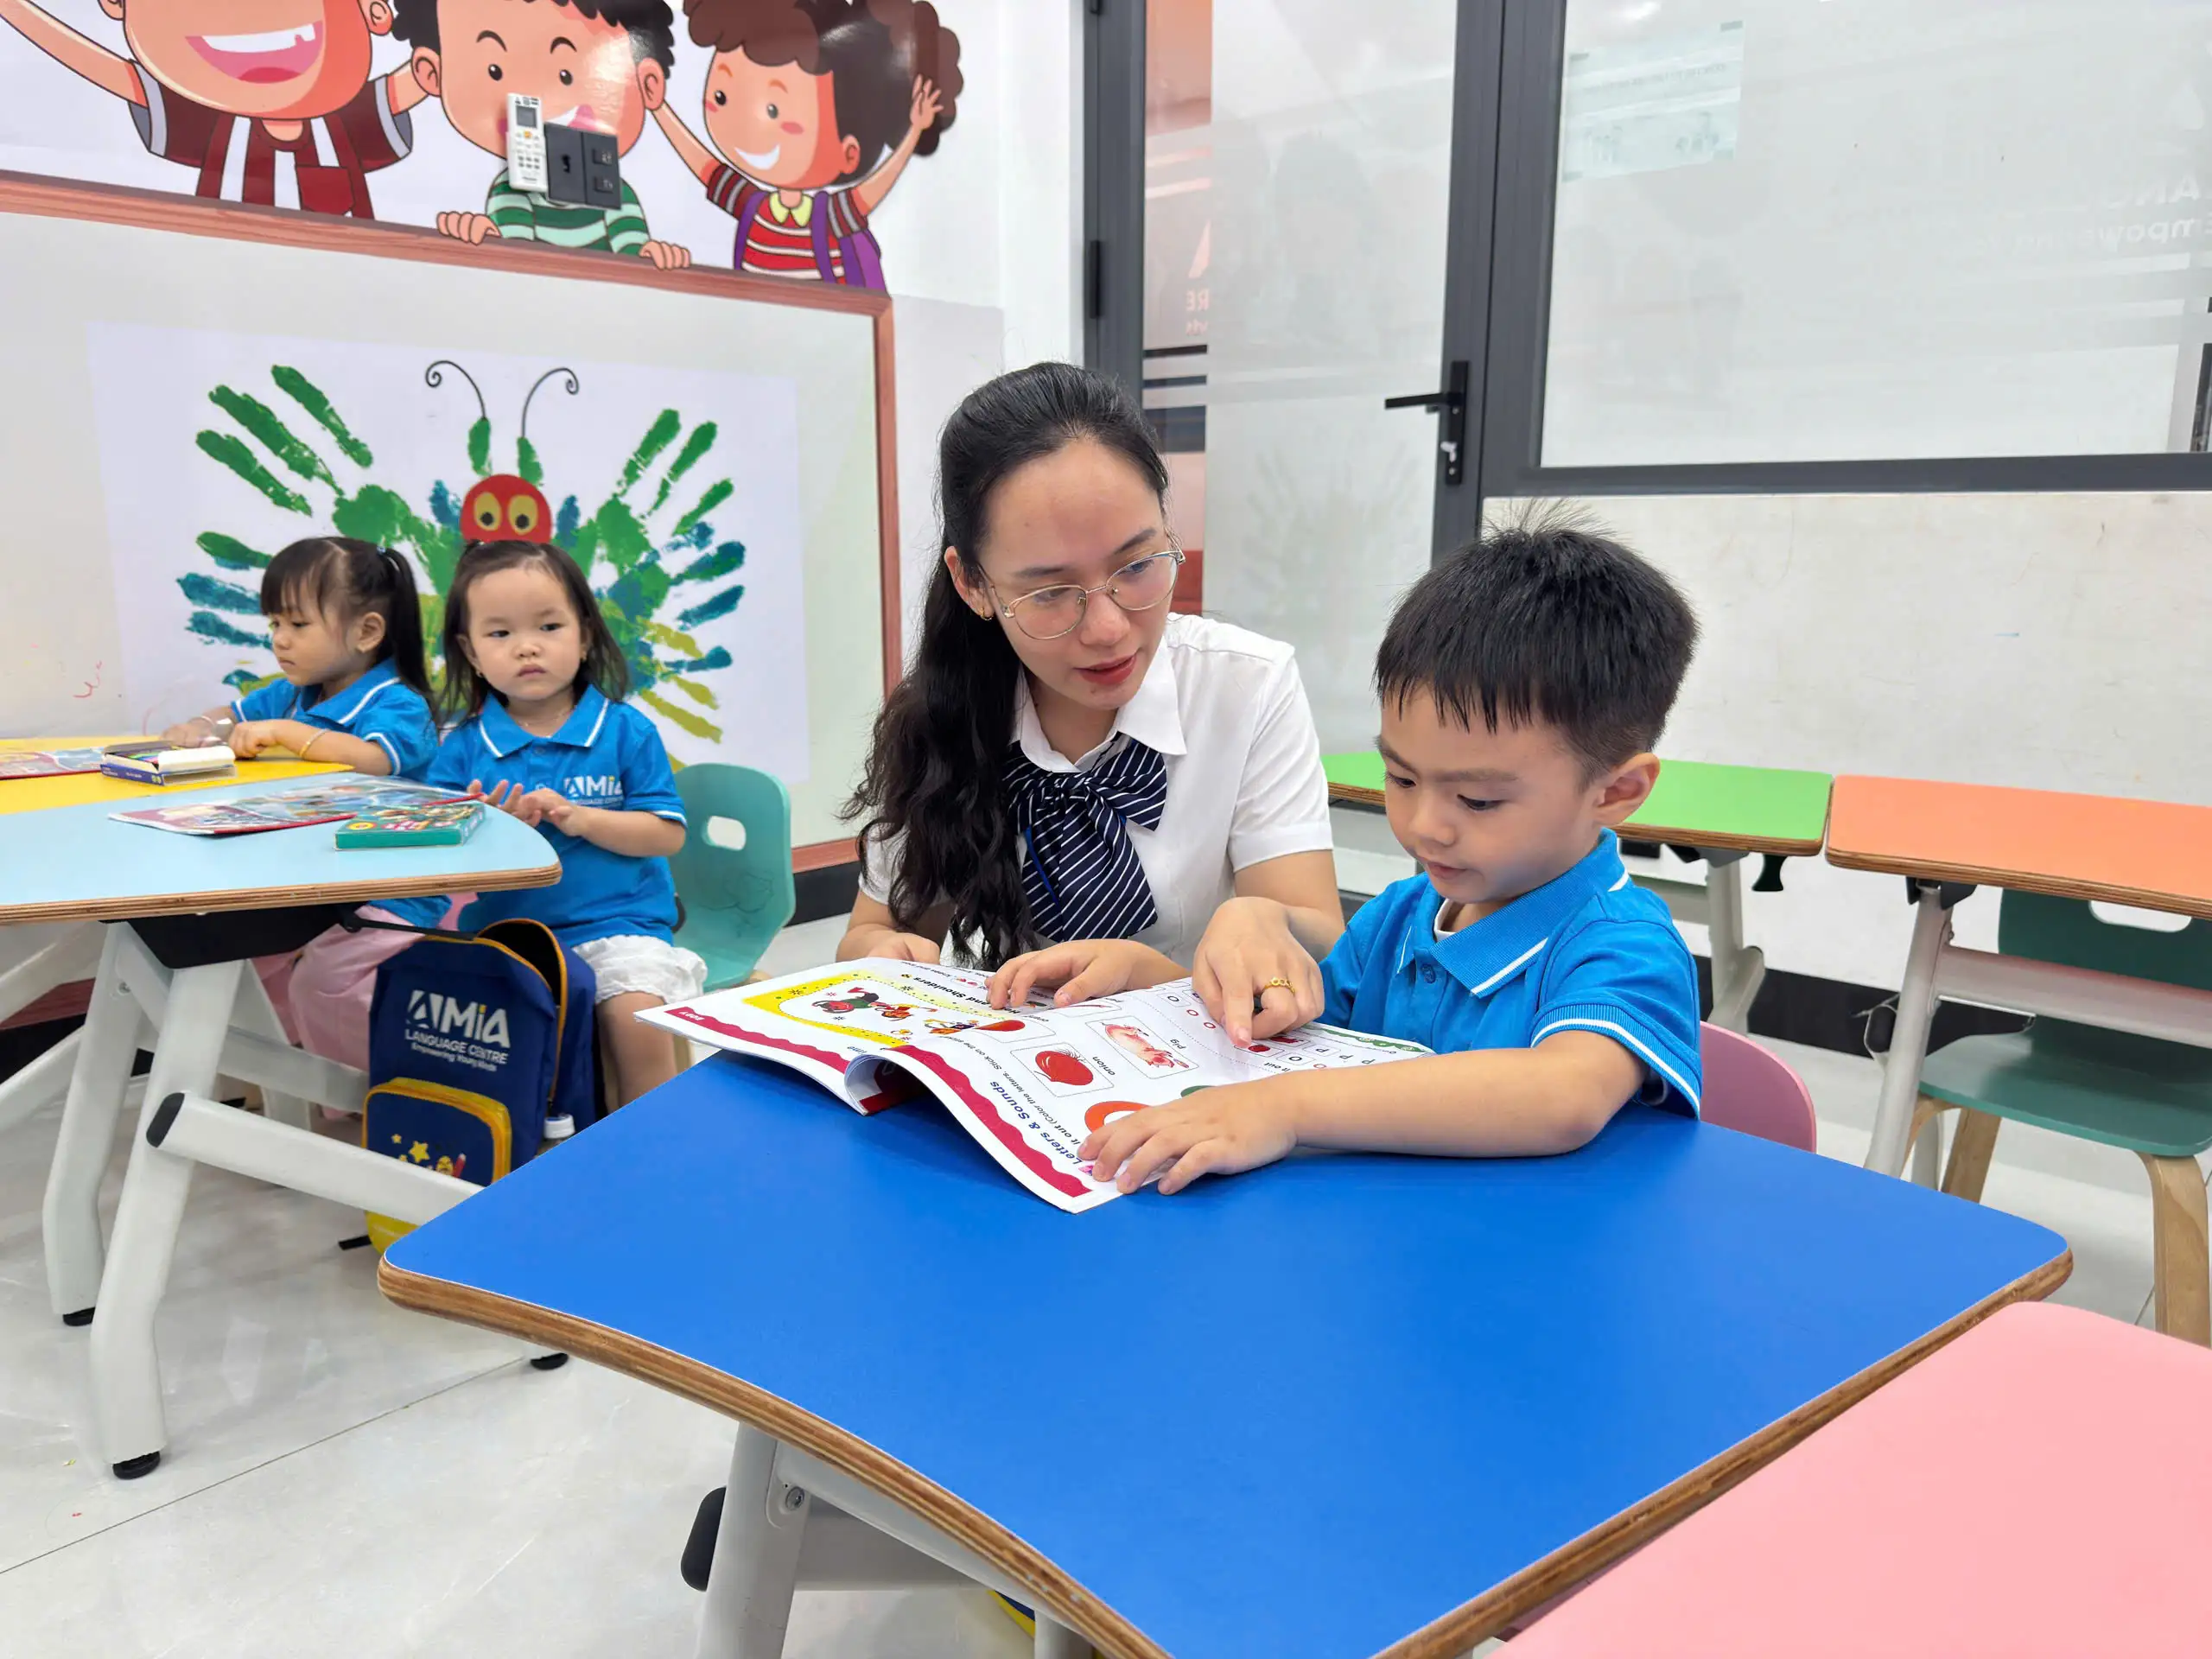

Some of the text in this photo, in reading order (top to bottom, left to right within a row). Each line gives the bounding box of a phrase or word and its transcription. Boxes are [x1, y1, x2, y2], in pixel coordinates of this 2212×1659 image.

[912, 976, 966, 998] Shoulders
[404, 1028, 509, 1065] LANGUAGE CENTRE
[1169, 1038, 1186, 1050] pig
[983, 1055, 1002, 1071] Stick
[1092, 1055, 1116, 1077] onion
[1002, 1071, 1025, 1093] letters.
[1023, 1093, 1036, 1104] the
[989, 1080, 1083, 1166] Letters & Sounds
[1033, 1105, 1058, 1125] (Color
[1053, 1124, 1072, 1138] out
